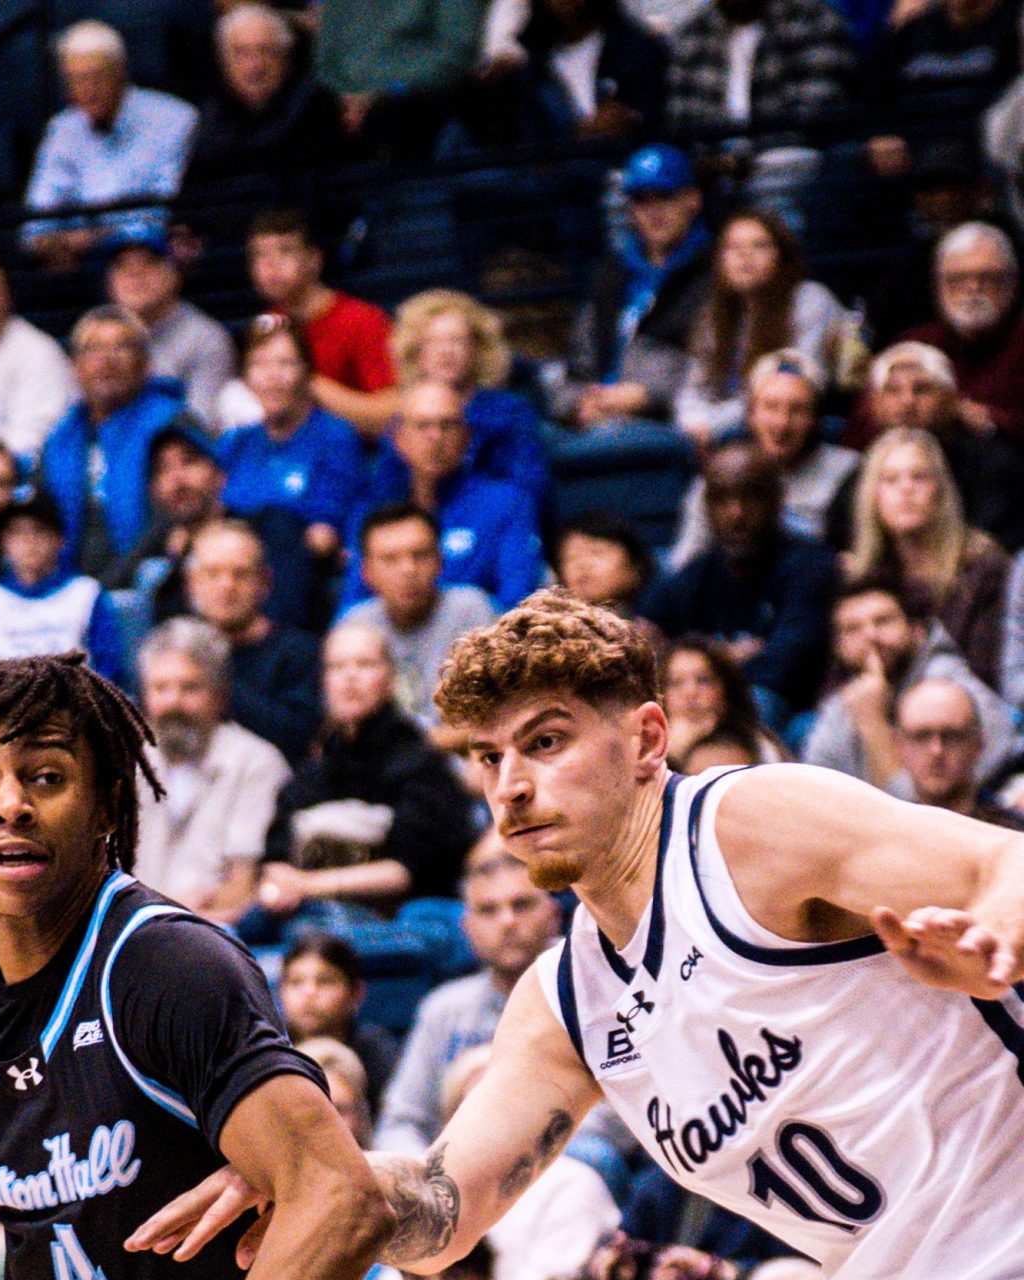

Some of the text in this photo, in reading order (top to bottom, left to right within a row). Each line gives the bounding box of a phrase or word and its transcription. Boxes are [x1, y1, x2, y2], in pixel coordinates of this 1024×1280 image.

[647, 1027, 803, 1176] Hawks
[42, 1119, 142, 1204] Hall
[745, 1117, 888, 1236] 10
